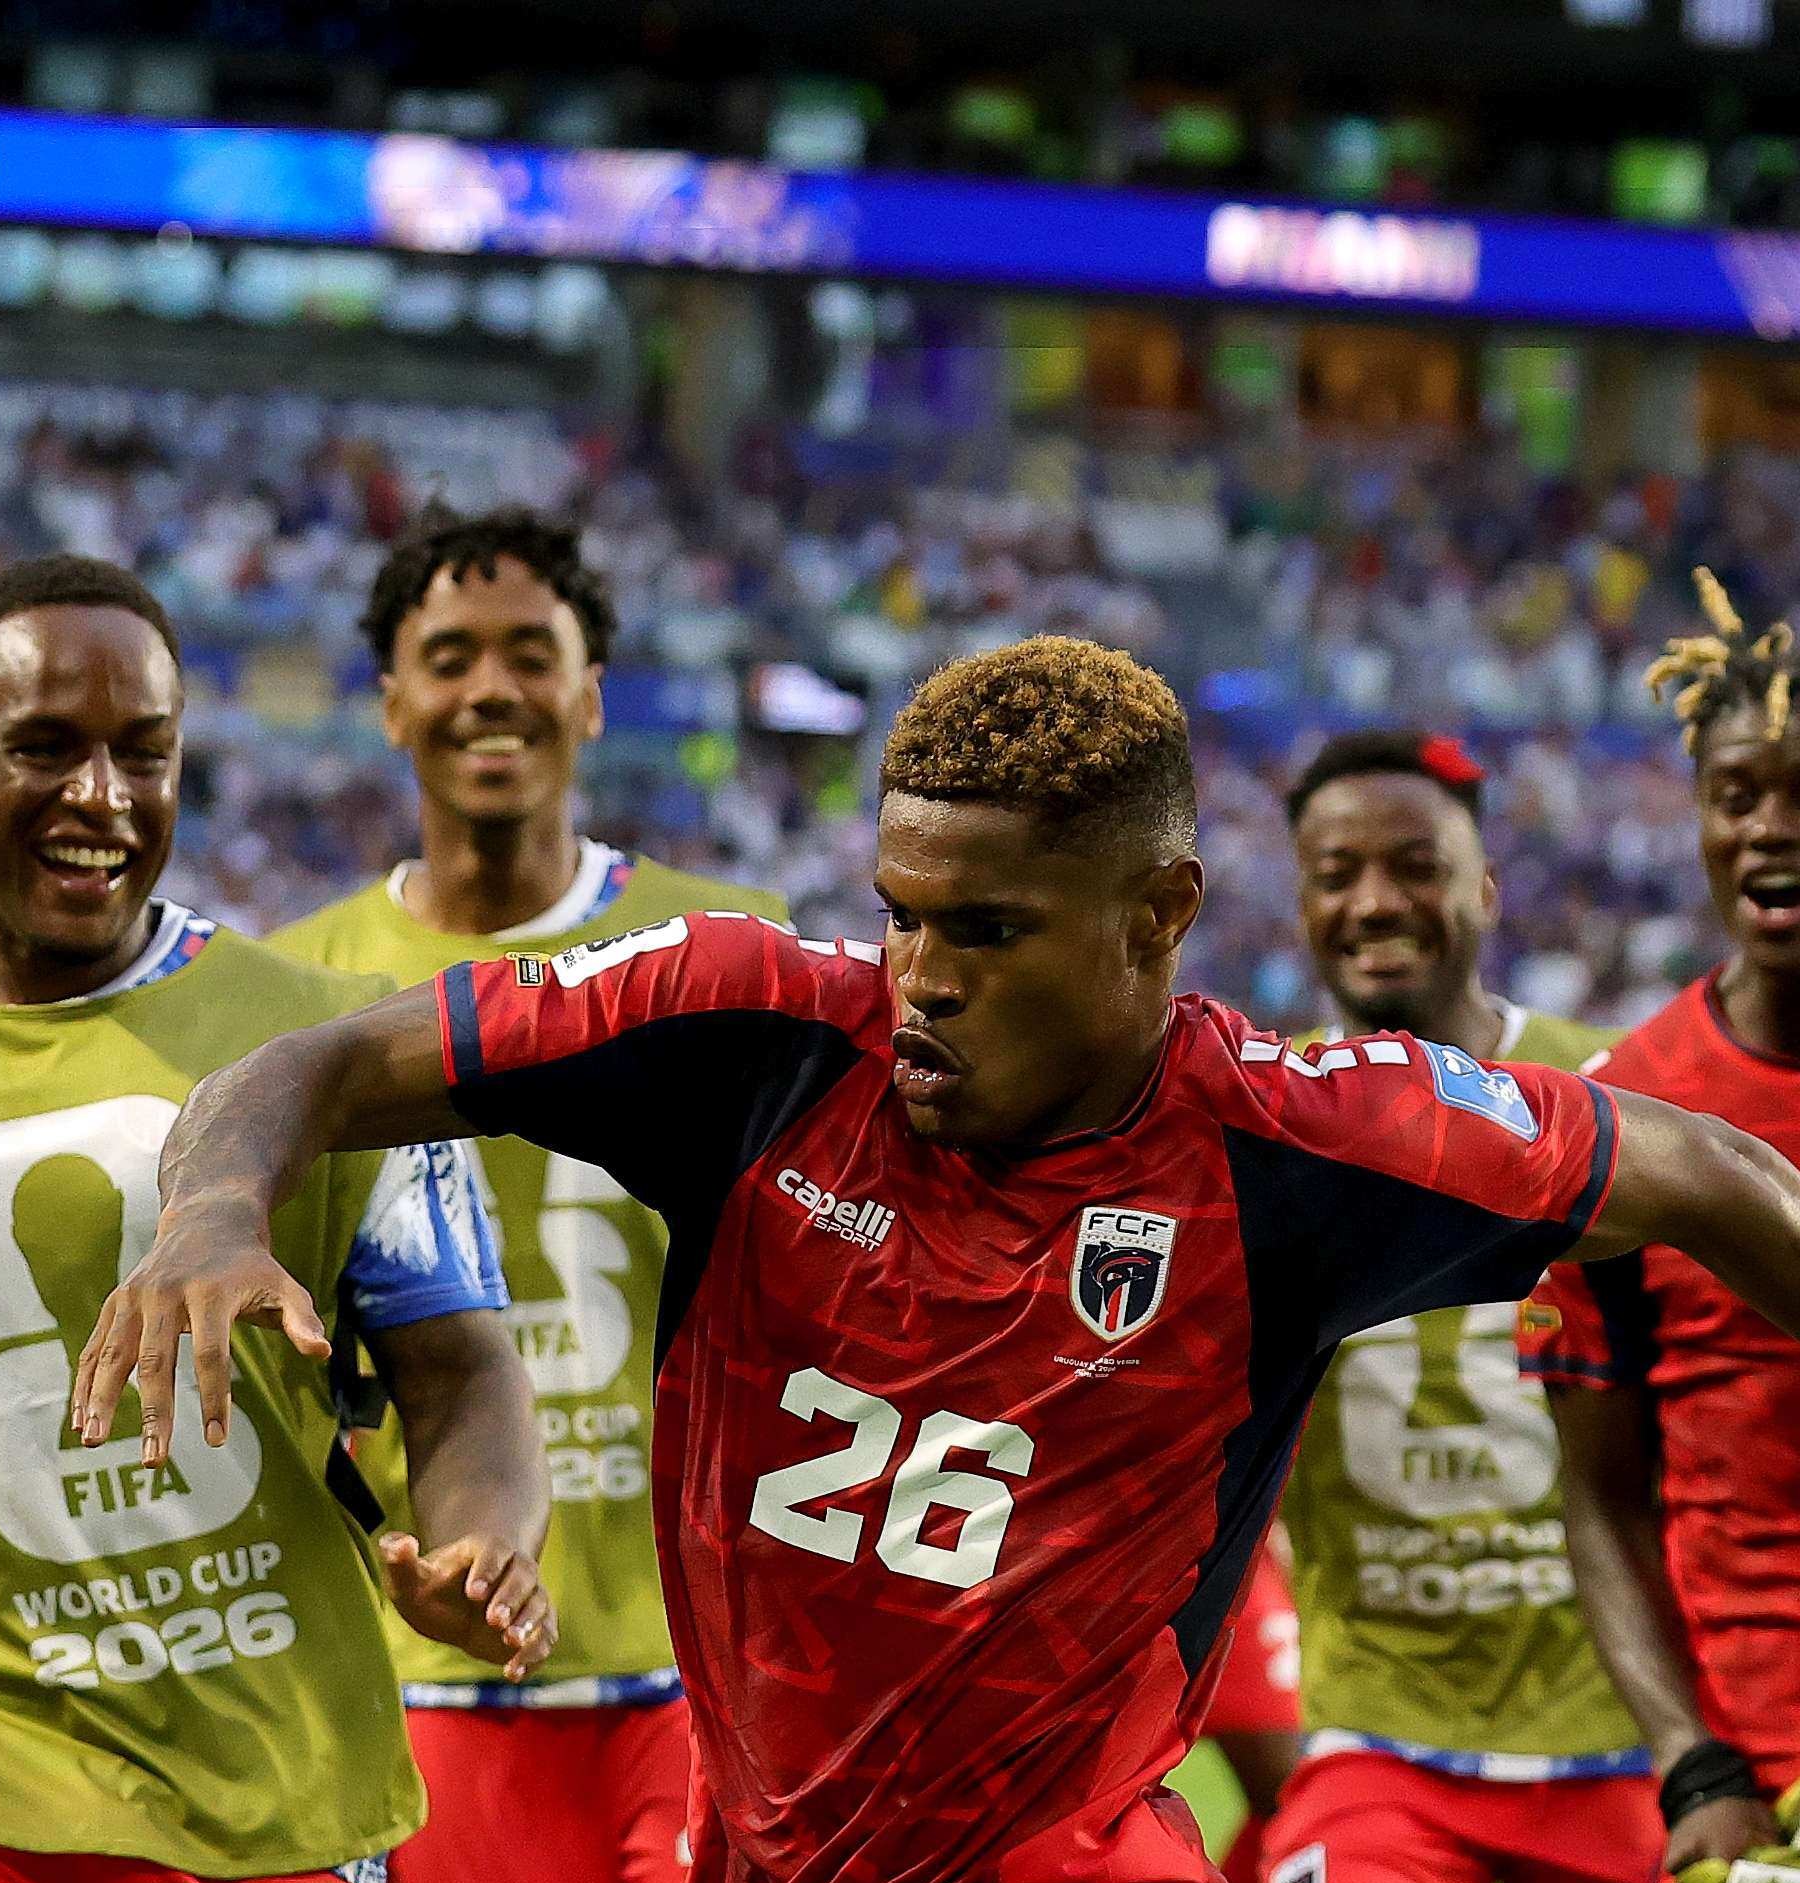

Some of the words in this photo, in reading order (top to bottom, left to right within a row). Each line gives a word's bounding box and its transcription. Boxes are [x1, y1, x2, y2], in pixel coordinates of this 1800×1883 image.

[776, 1168, 896, 1243] capelli
[814, 1216, 881, 1252] SPORT
[1088, 1212, 1169, 1237] FCF
[516, 1321, 581, 1358] IFA
[62, 1457, 192, 1518] FIFA
[548, 1446, 649, 1502] 26
[749, 1367, 1035, 1591] 26
[13, 1571, 183, 1629] WORLD
[191, 1541, 283, 1599] CUP
[30, 1591, 298, 1689] 2026
